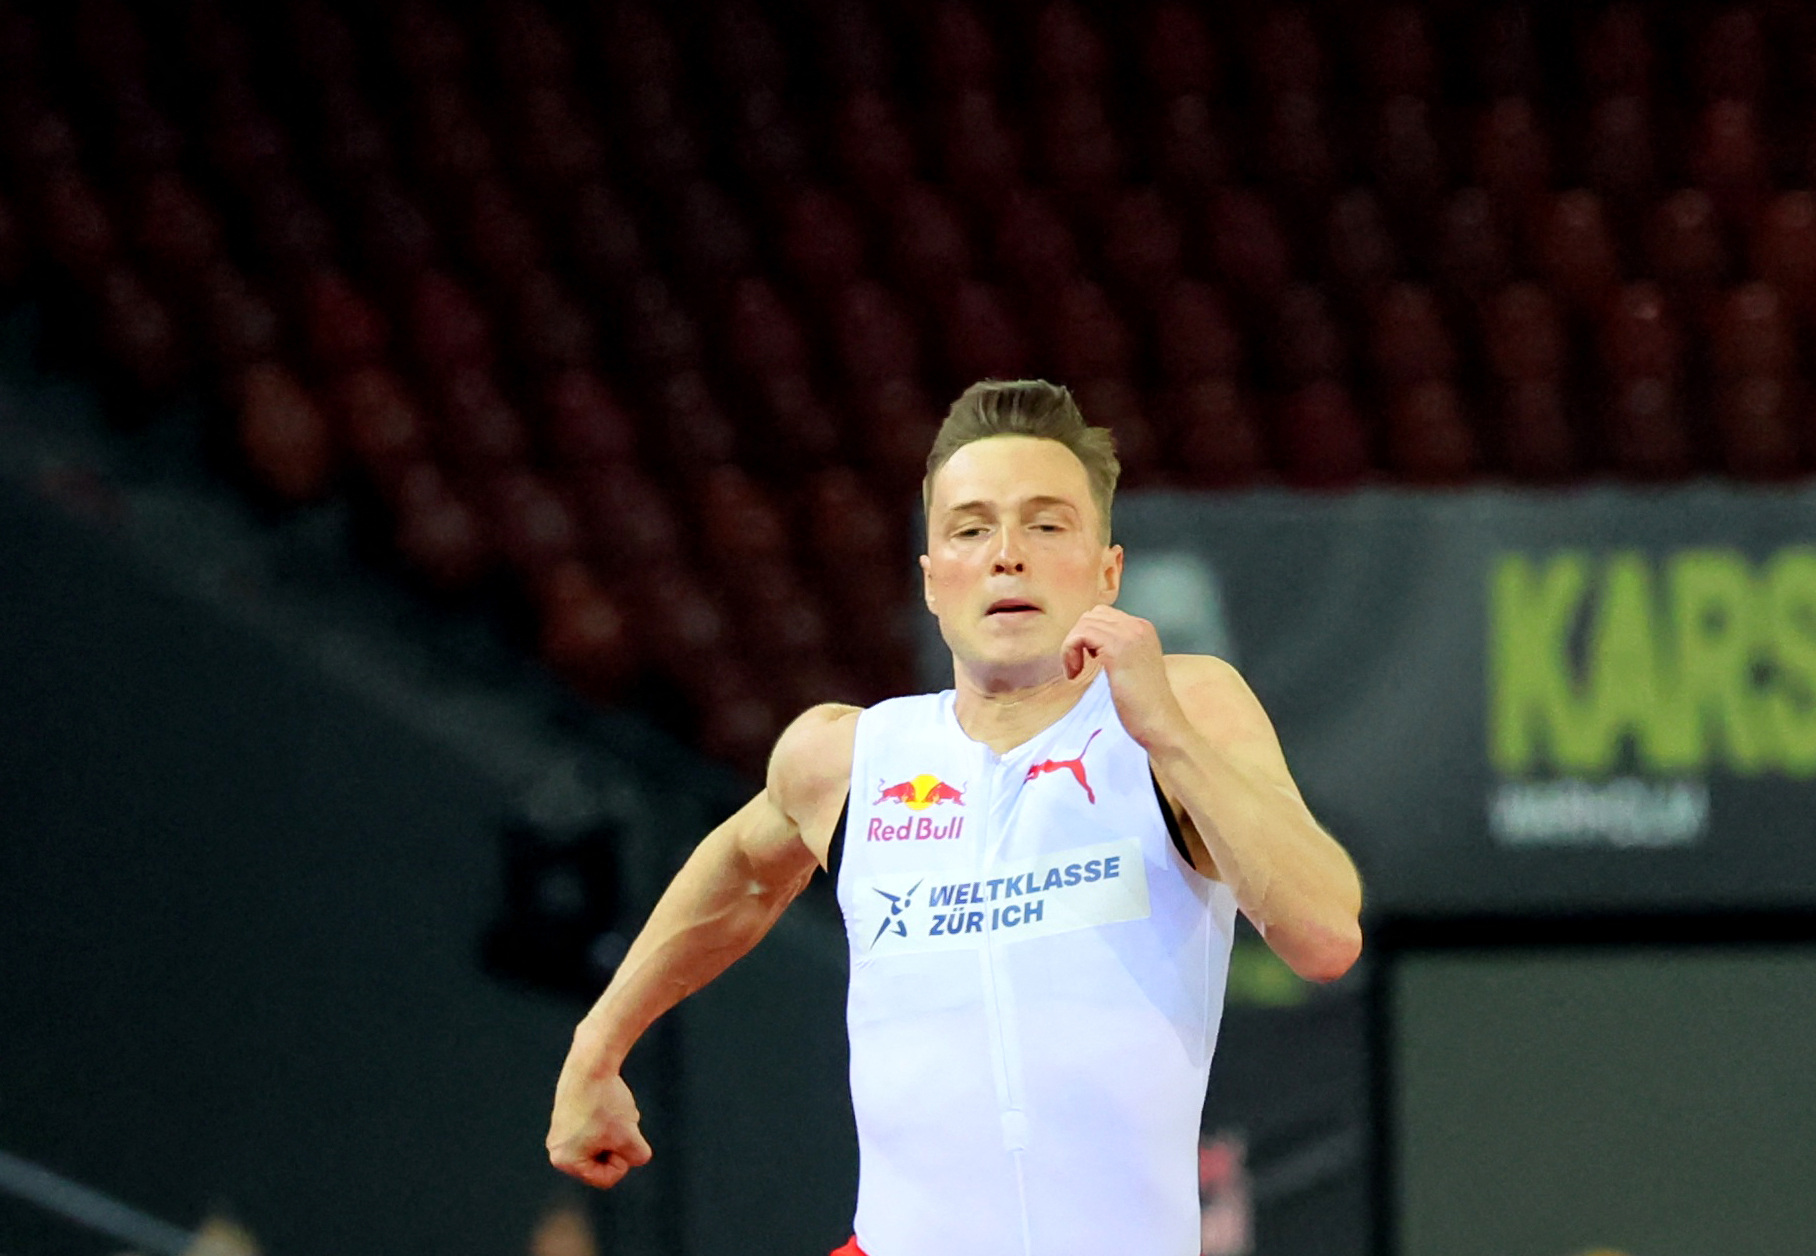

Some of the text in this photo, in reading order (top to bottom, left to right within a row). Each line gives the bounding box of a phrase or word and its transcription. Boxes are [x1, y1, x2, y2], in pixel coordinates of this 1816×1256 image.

[867, 816, 963, 842] Red Bull
[929, 856, 1120, 907] WELTKLASSE
[928, 900, 1044, 936] ZÜRICH
